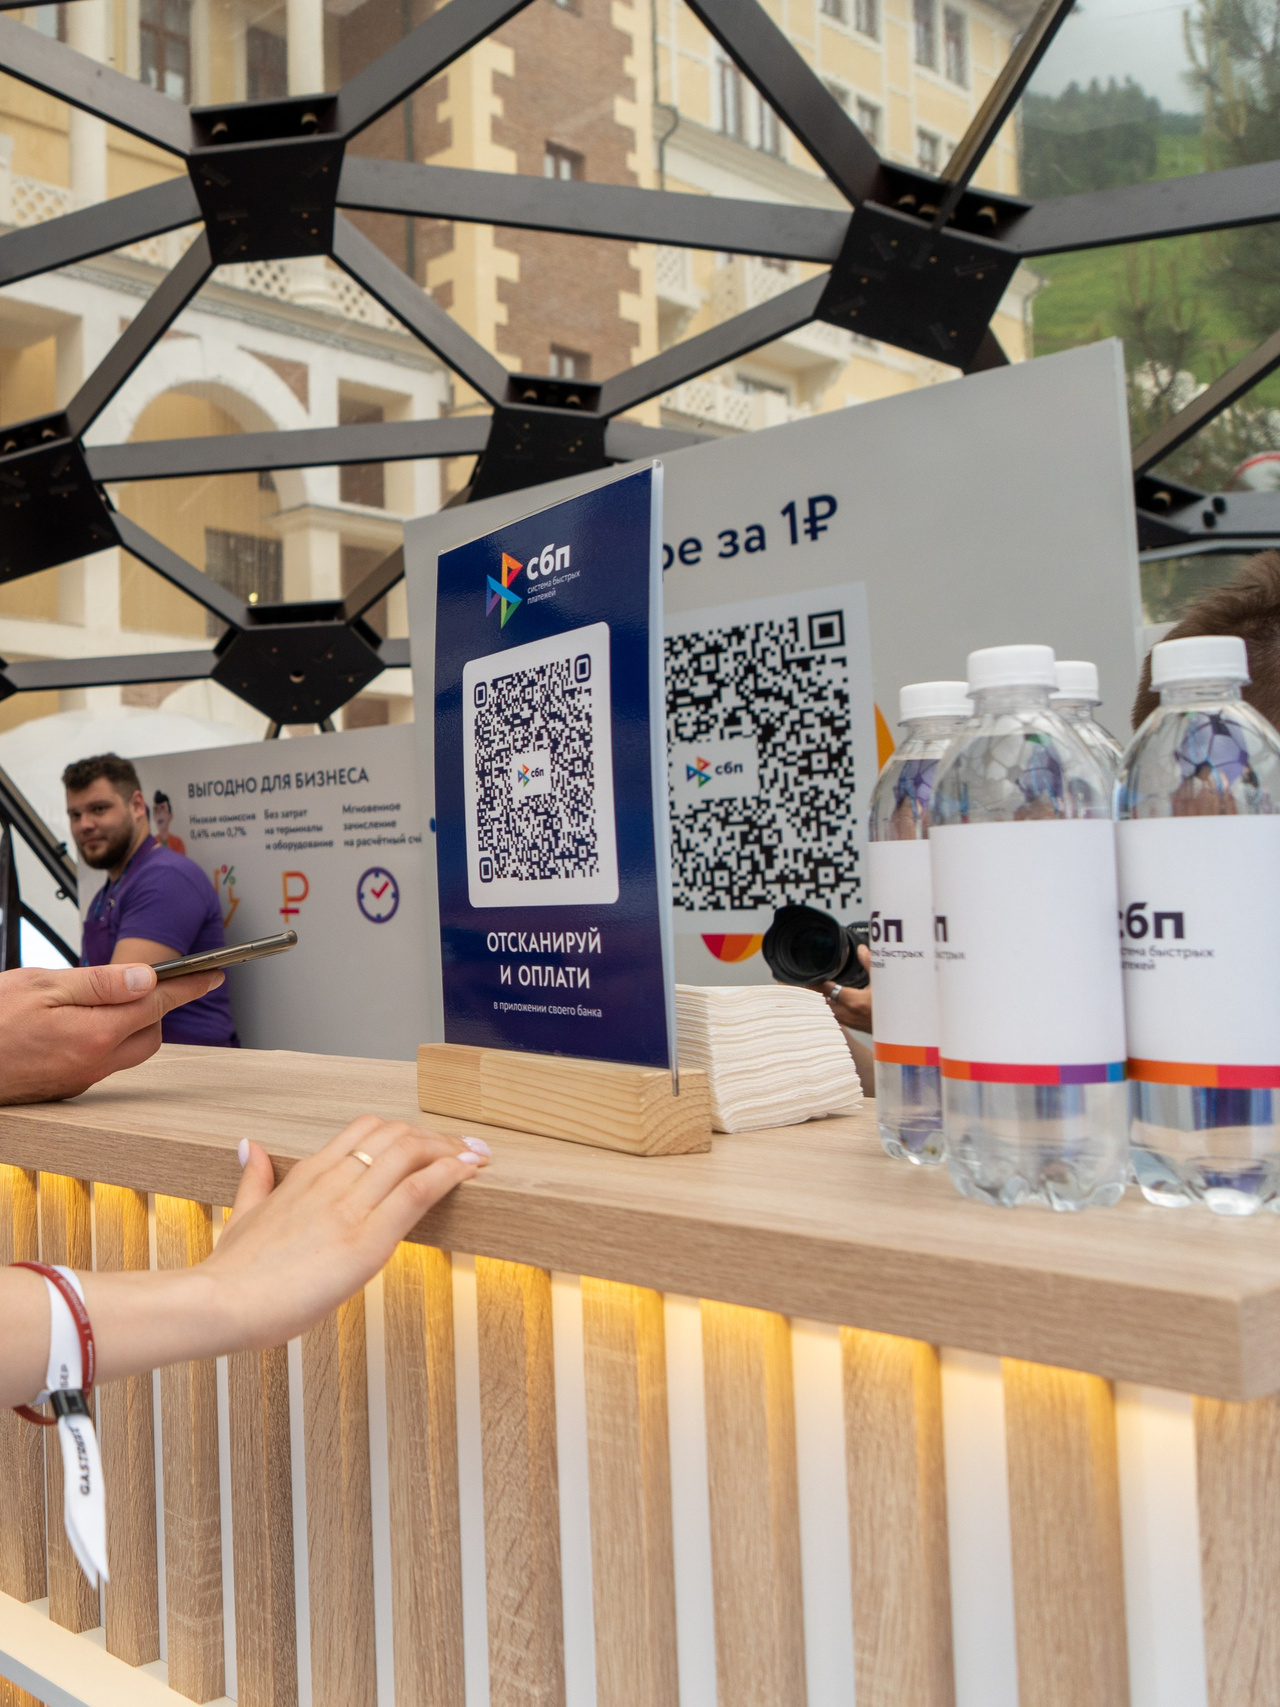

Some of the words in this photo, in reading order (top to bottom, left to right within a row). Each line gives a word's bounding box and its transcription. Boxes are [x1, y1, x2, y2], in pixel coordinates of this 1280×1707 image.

[717, 523, 766, 559] за
[780, 494, 838, 546] 1₽
[526, 543, 570, 580] сбп
[527, 579, 552, 594] система
[552, 570, 581, 586] быстрых
[527, 588, 557, 605] платежей
[531, 767, 544, 778] сбп
[715, 761, 743, 775] сбп
[187, 777, 257, 798] ВЫГОДНО
[260, 774, 292, 794] ДЛЯ
[295, 767, 369, 789] БИЗНЕСА
[264, 809, 279, 820] Без
[281, 808, 308, 821] затрат
[342, 802, 401, 816] Мгновенное
[189, 814, 217, 824] Низкая
[218, 813, 256, 823] комиссия
[343, 819, 397, 831] зачисление
[211, 830, 225, 838] или
[227, 826, 247, 838] 0,7%
[265, 827, 274, 835] на
[276, 823, 323, 835] терминалы
[272, 838, 334, 852] оборудование
[344, 838, 355, 847] на
[356, 833, 406, 849] расчётный
[870, 911, 903, 943] бп
[486, 926, 602, 954] ОТСКАНИРУЙ
[881, 948, 924, 960] быстрых
[1148, 945, 1215, 961] быстрых
[500, 964, 512, 985] И
[518, 965, 591, 989] ОПЛАТИ
[493, 1001, 499, 1010] в
[499, 1001, 547, 1014] приложении
[548, 1004, 576, 1016] своего
[577, 1004, 602, 1018] банка
[71, 1427, 90, 1496] GASTREET
